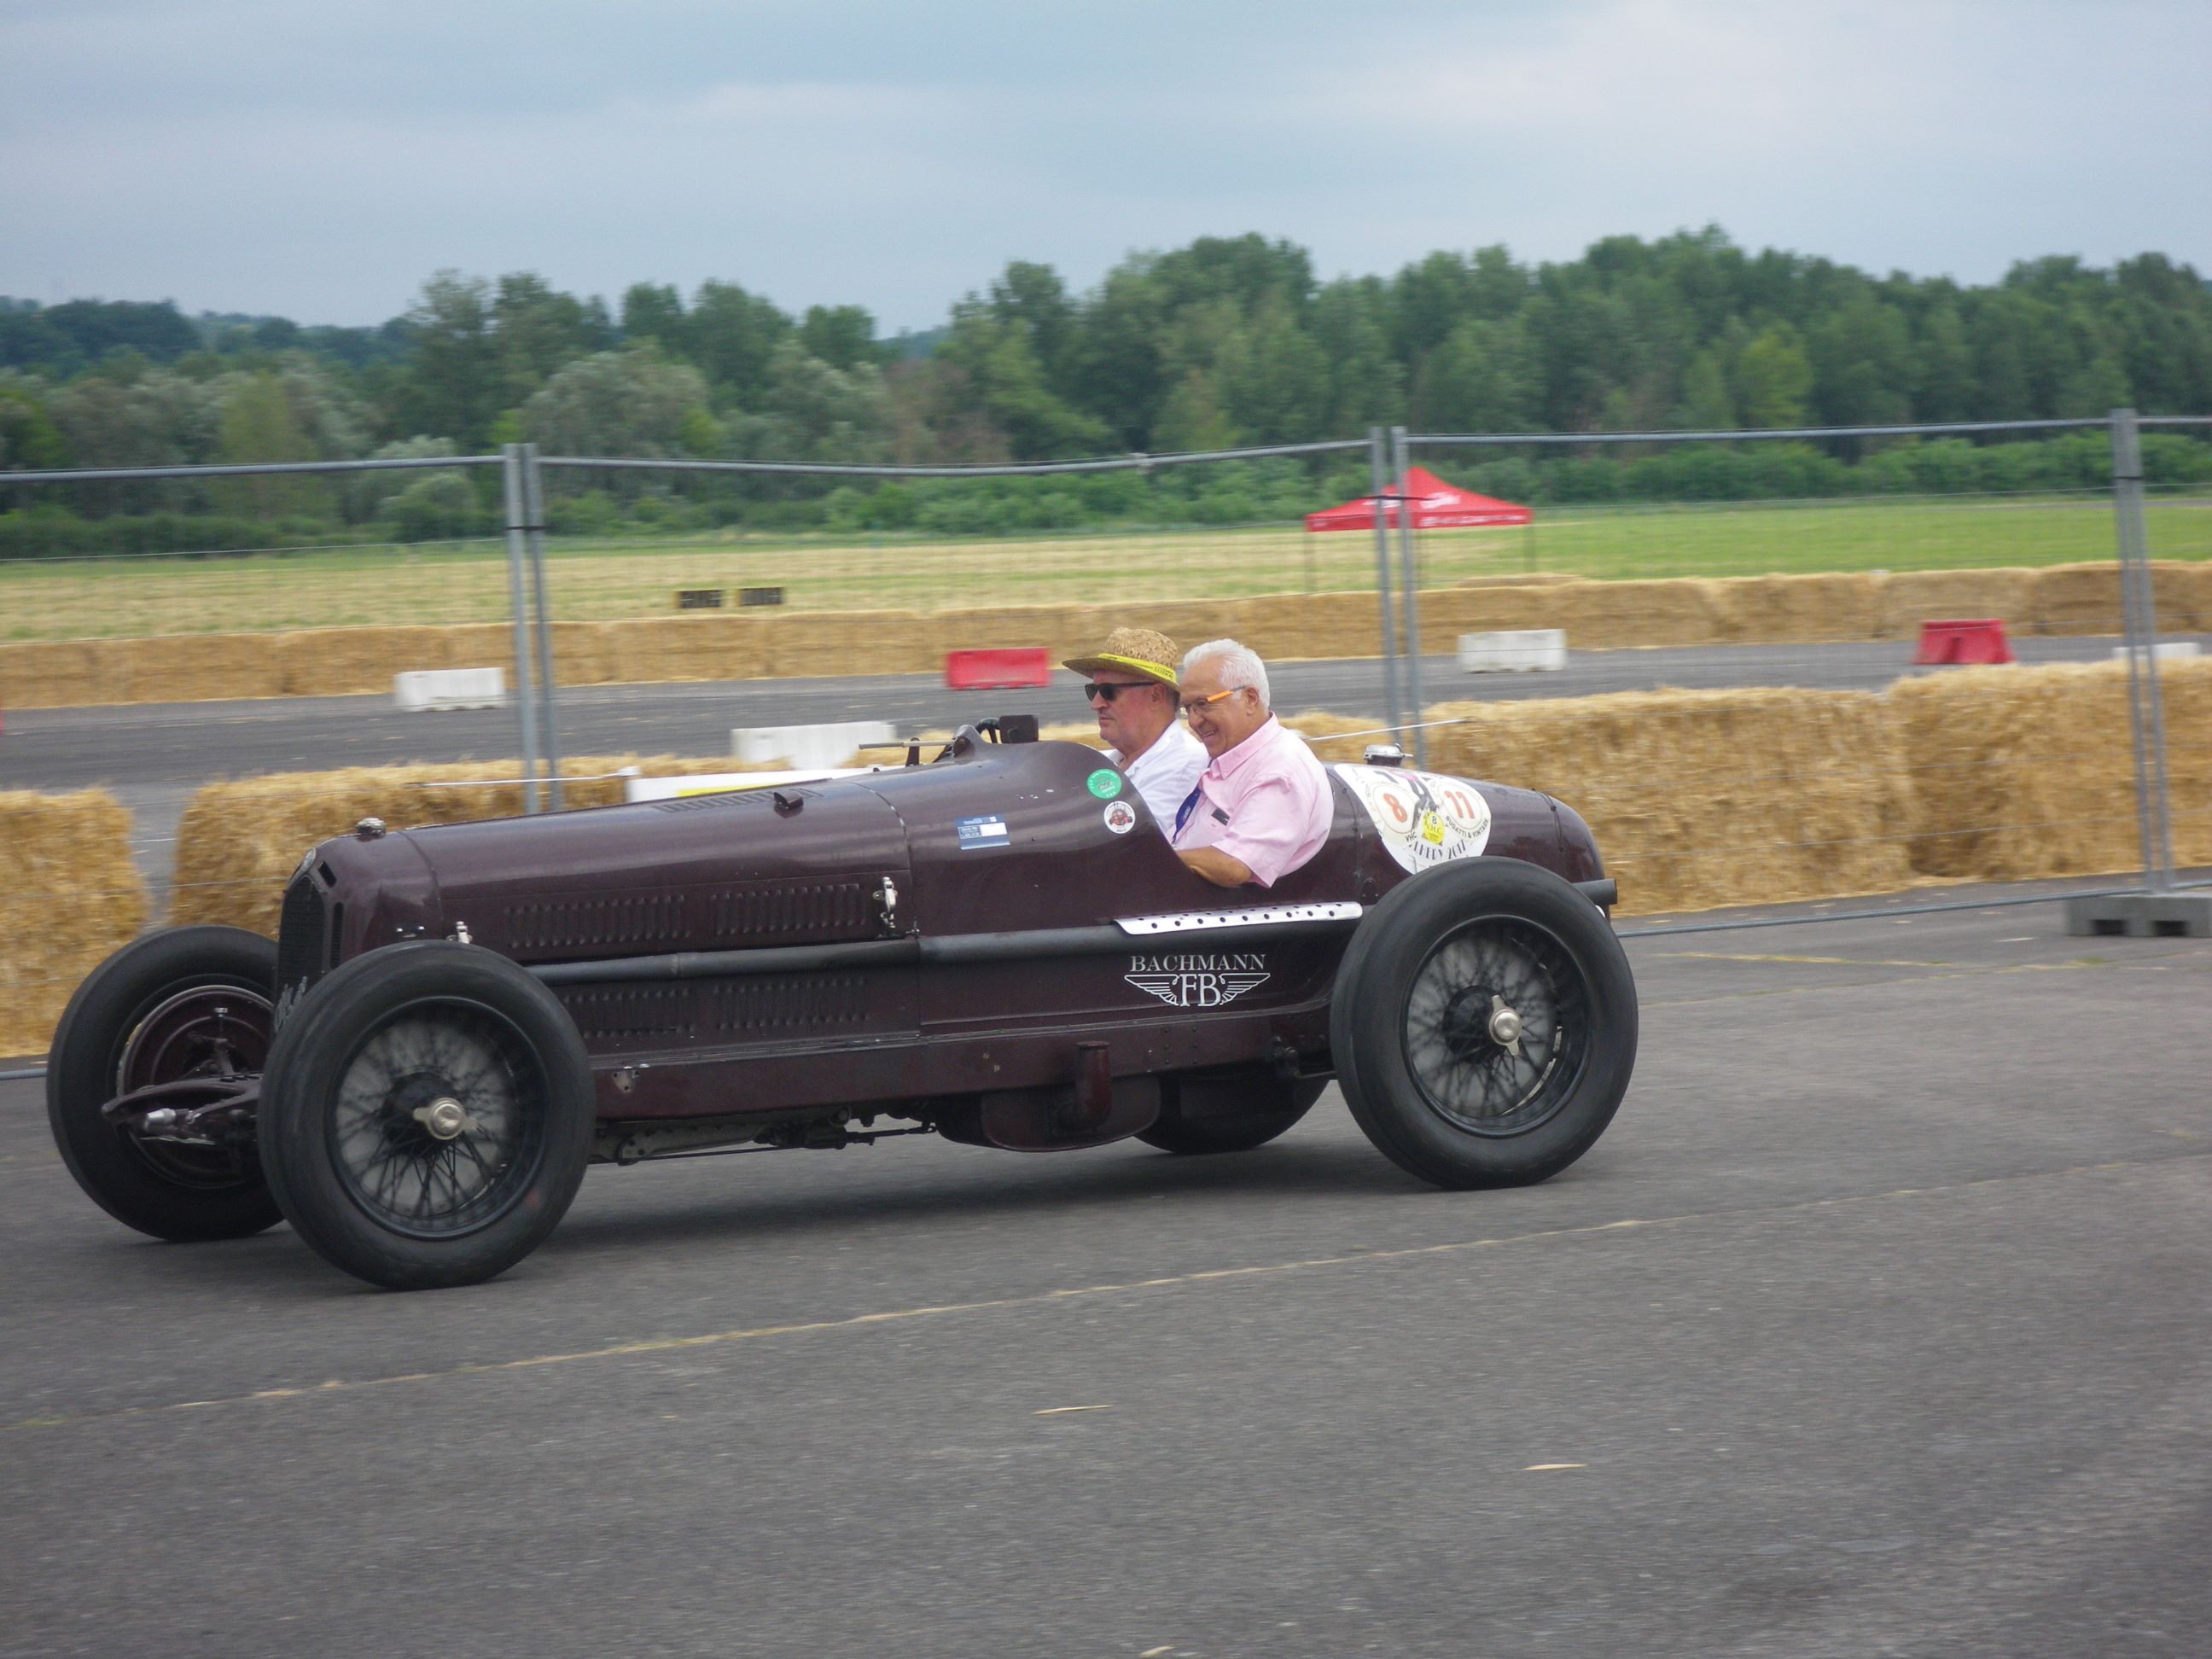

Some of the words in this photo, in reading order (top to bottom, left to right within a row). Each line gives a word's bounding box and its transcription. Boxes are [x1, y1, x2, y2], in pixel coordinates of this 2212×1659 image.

[1383, 794, 1407, 823] 8
[1444, 791, 1475, 818] 11
[1406, 833, 1417, 841] VHC
[1130, 954, 1266, 971] BACHMANN
[1179, 973, 1221, 1007] FB
